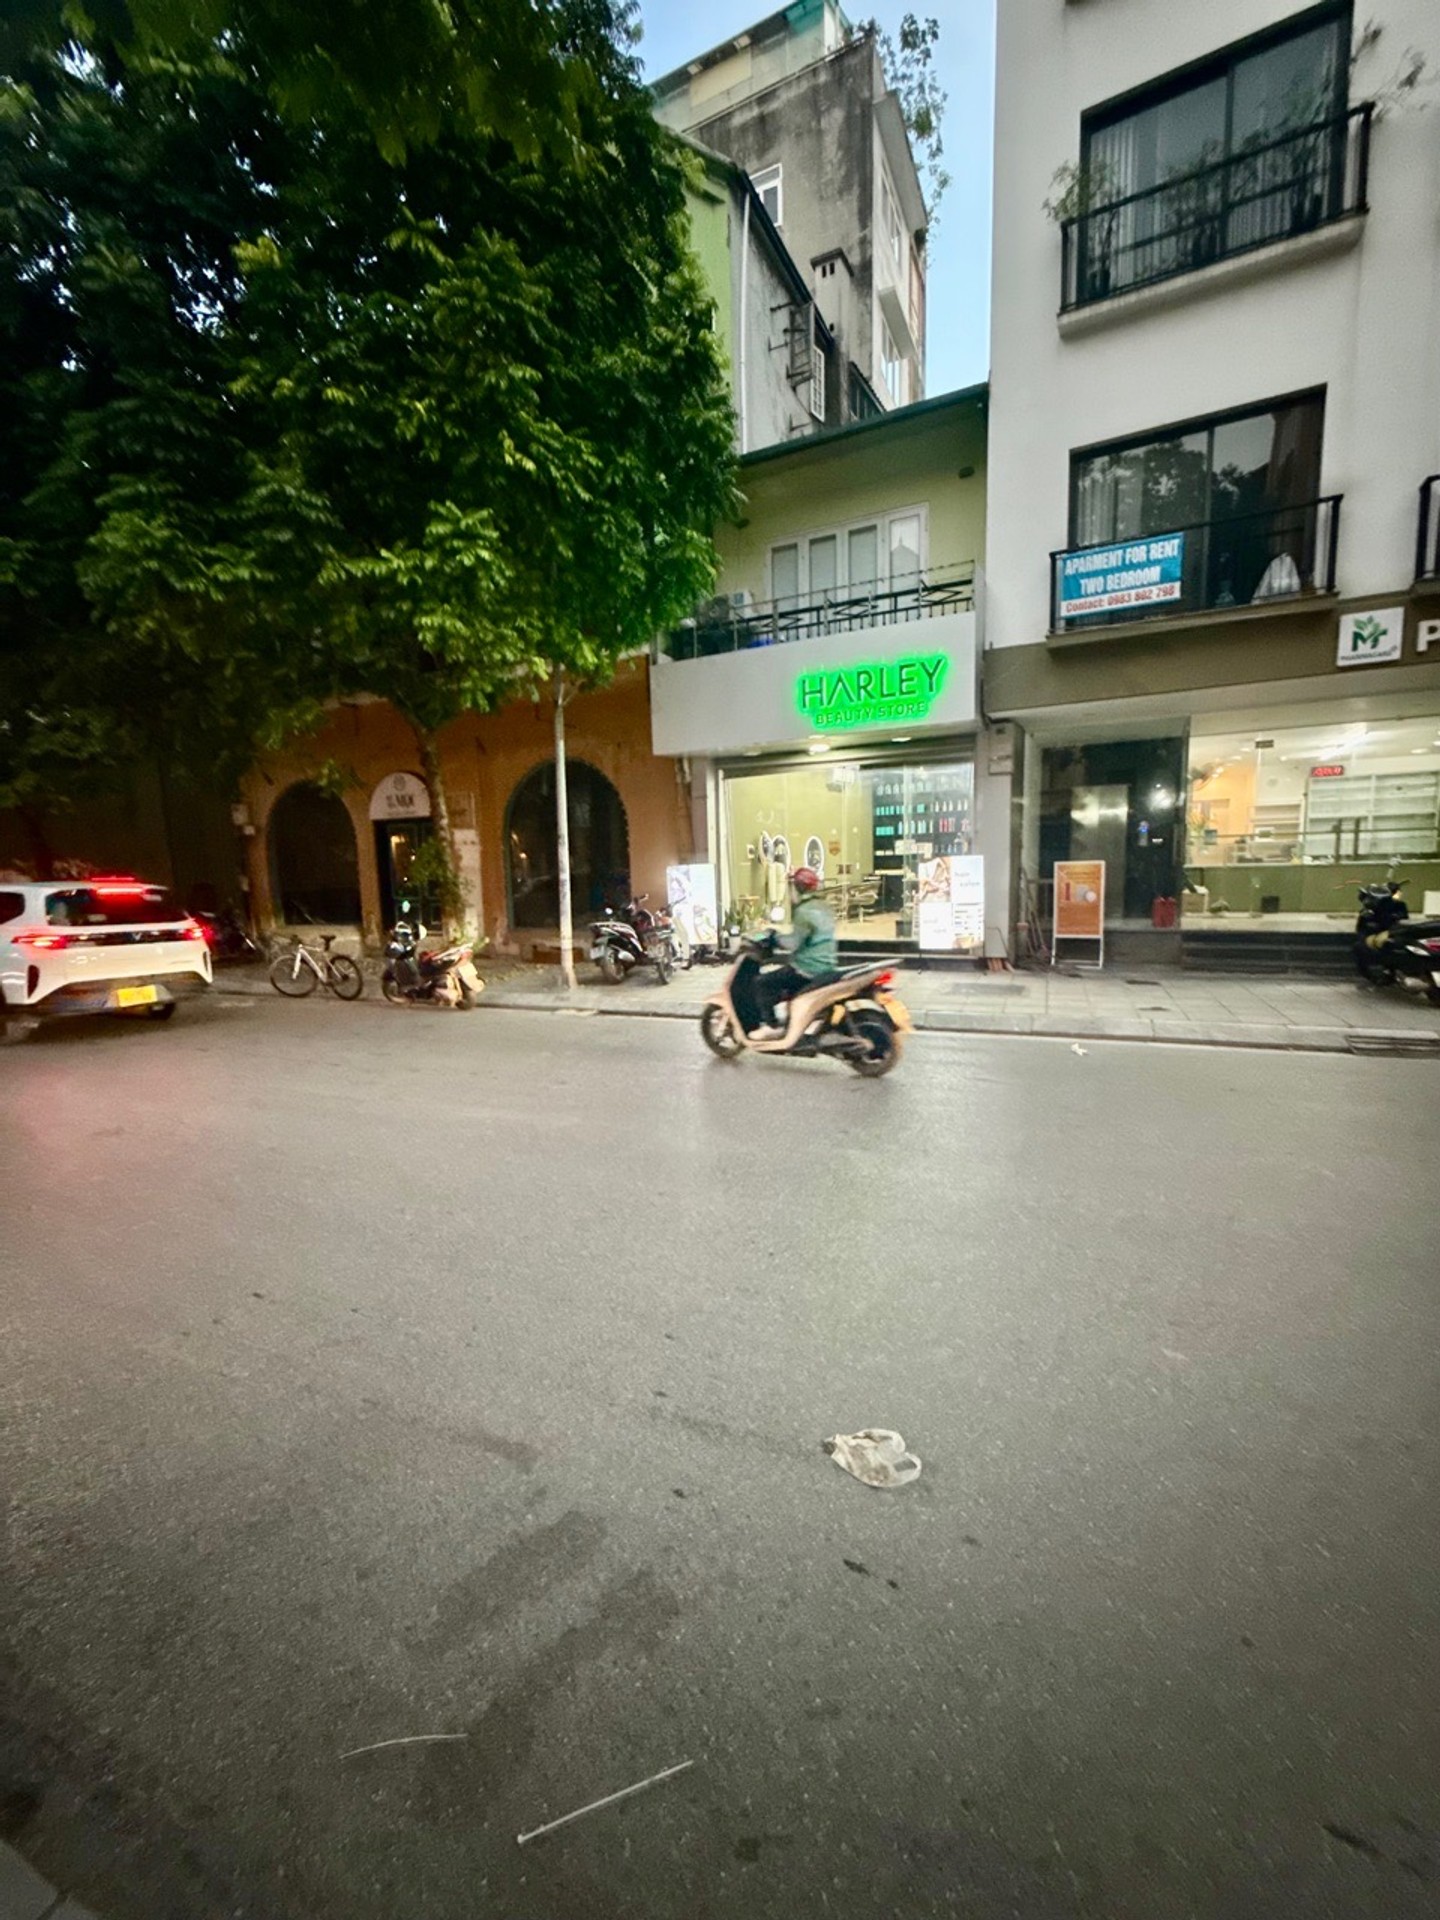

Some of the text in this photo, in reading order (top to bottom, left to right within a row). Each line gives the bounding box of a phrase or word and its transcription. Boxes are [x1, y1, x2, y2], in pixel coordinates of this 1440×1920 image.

[1125, 544, 1148, 565] FOR
[1149, 538, 1180, 561] RENT
[1080, 565, 1162, 595] TWO BEDROOM
[801, 657, 945, 709] HARLEY
[816, 701, 926, 726] BEAUTY STORE
